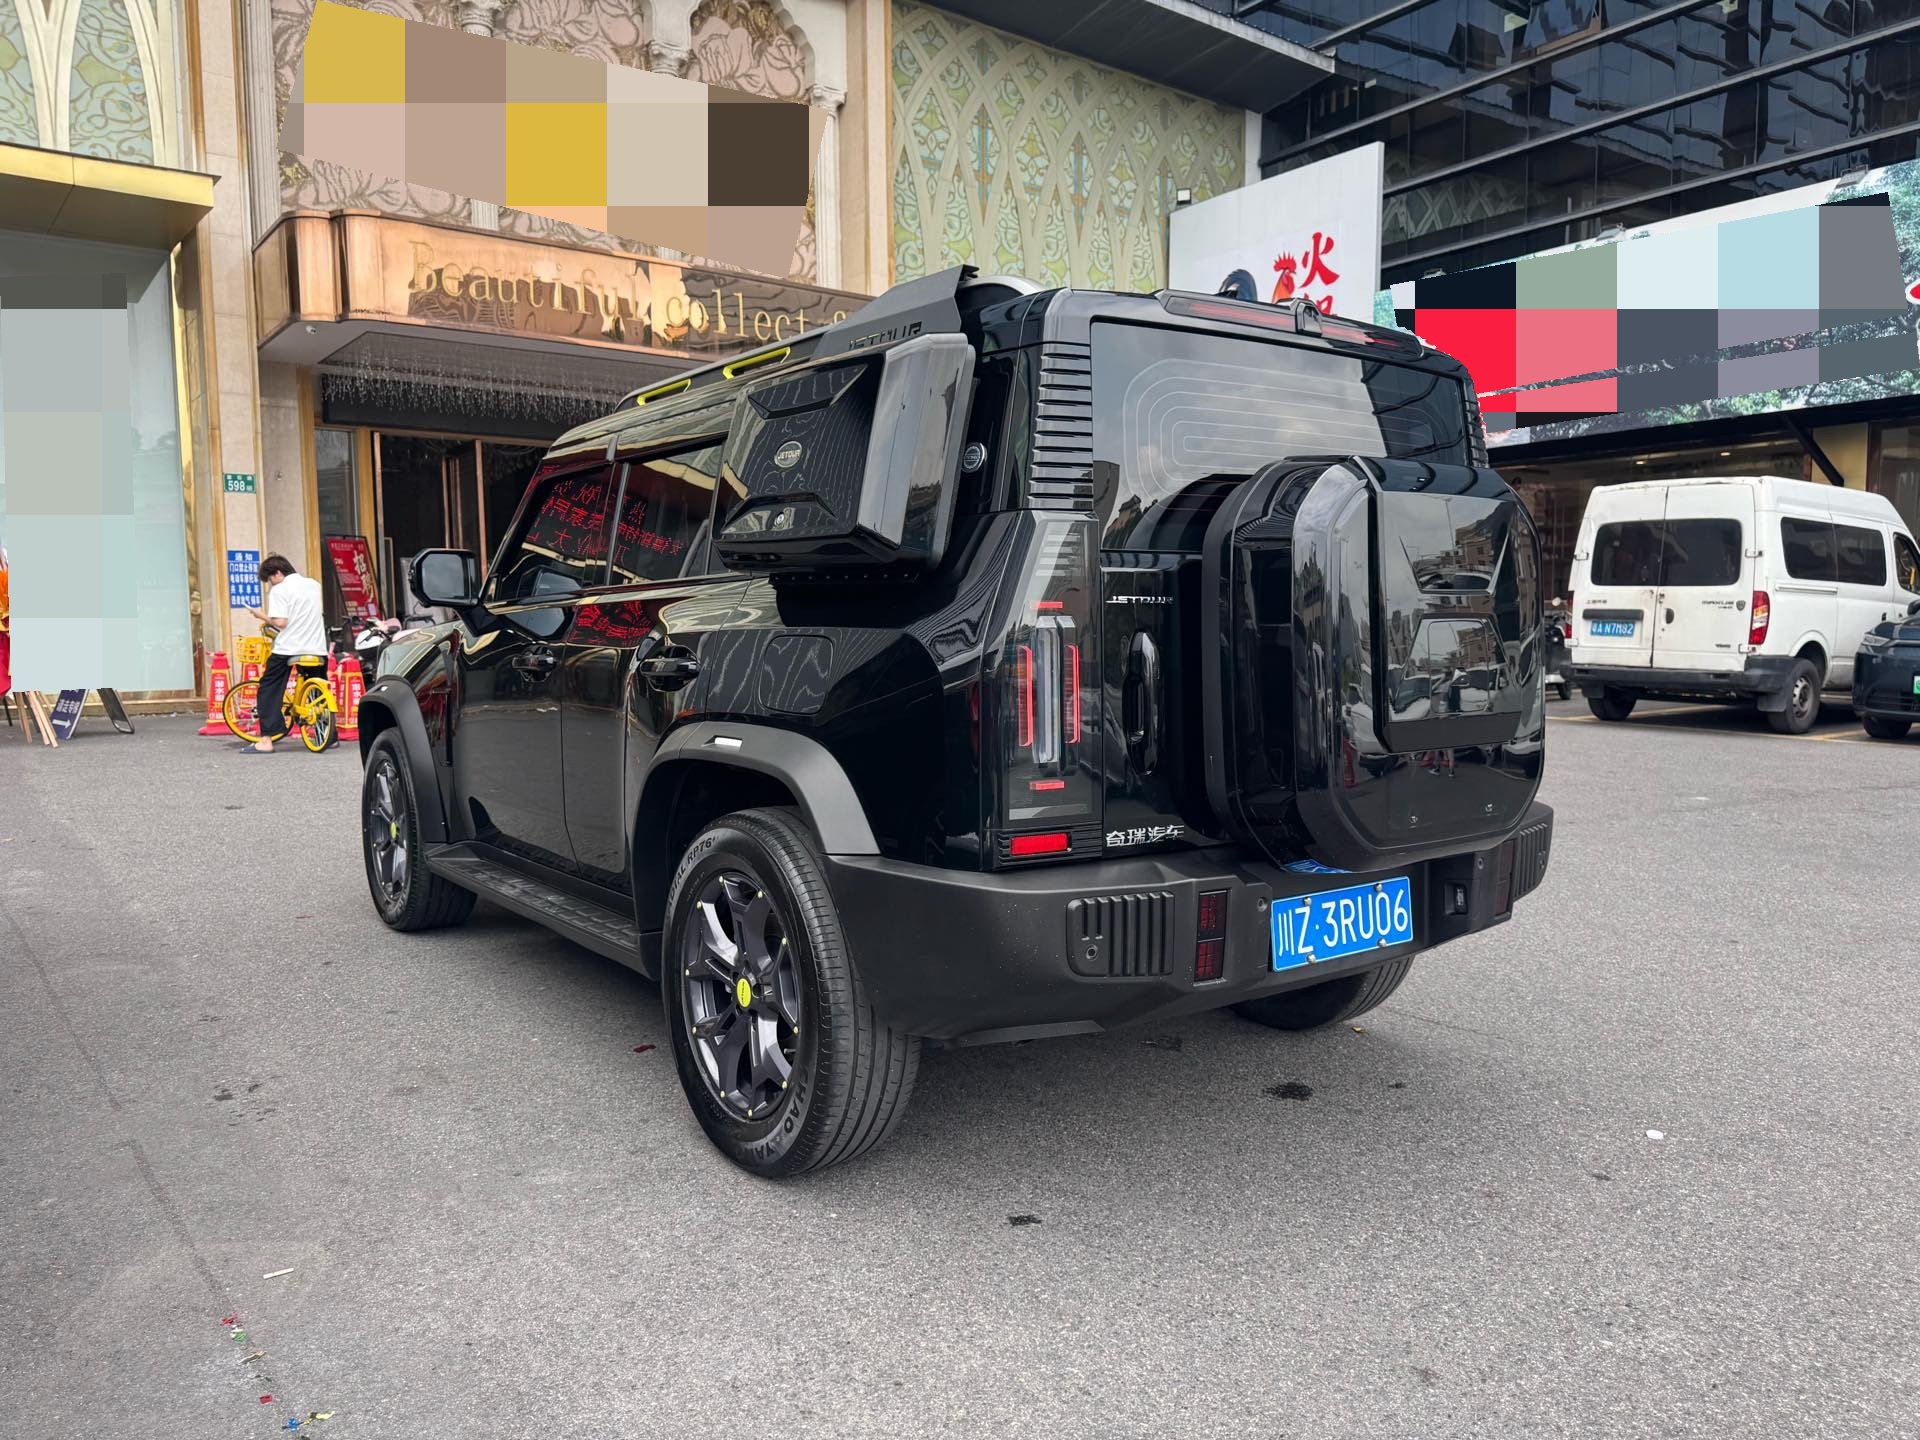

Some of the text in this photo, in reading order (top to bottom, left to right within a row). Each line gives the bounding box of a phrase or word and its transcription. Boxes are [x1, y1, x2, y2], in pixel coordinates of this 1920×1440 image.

[408, 240, 809, 341] Beautiful collect
[1105, 595, 1173, 604] JETOUR
[1106, 824, 1185, 848] 奇瑞汽车
